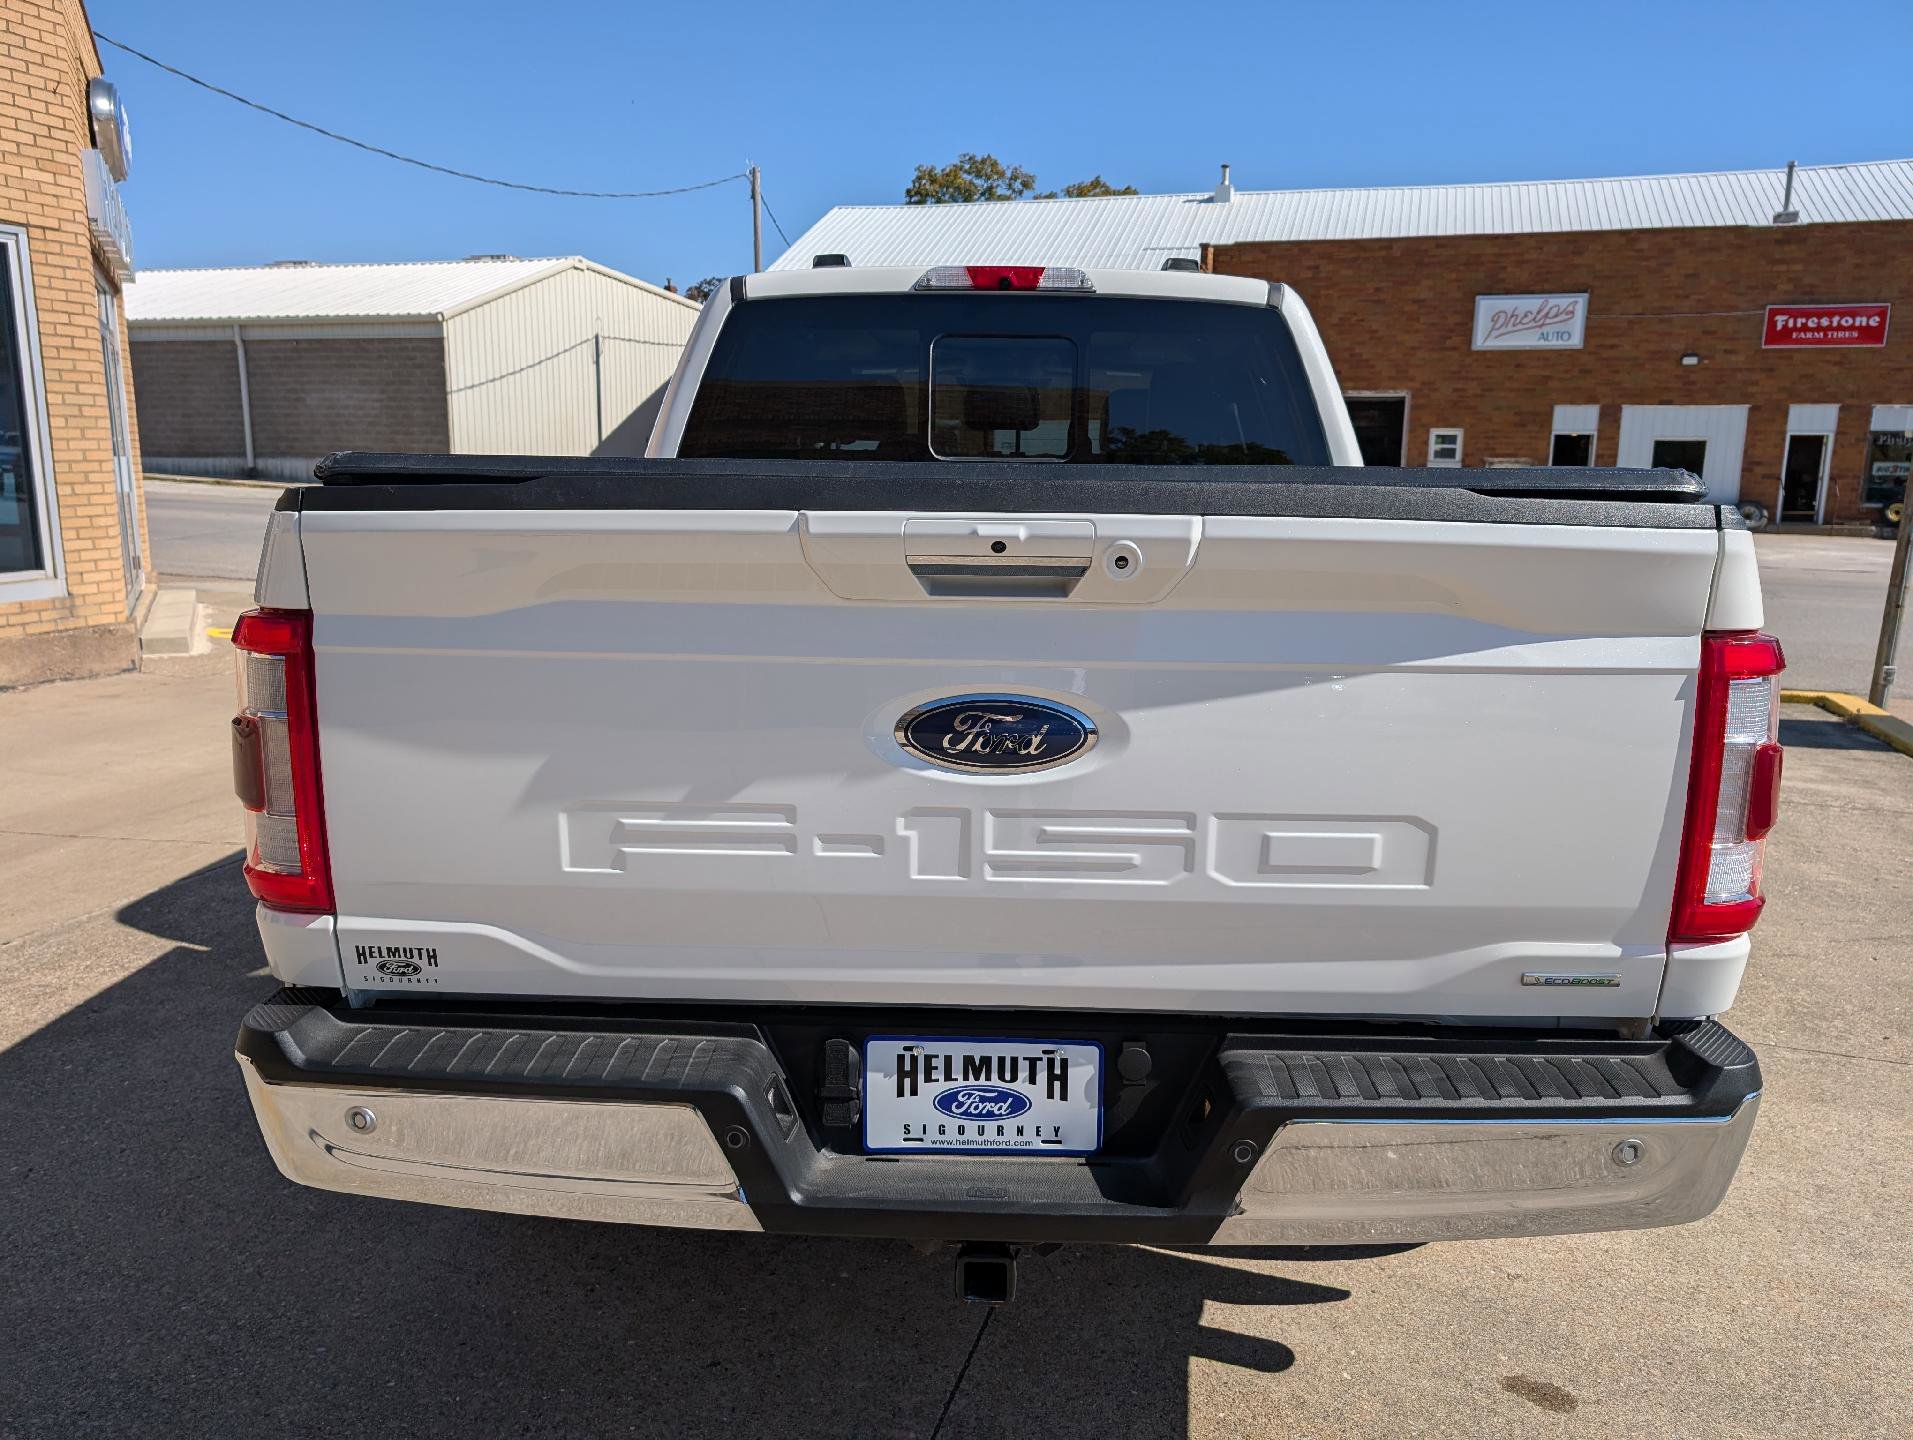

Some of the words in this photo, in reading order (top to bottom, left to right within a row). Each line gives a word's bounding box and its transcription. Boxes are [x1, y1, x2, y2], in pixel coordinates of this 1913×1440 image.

[1482, 299, 1578, 344] Phelps
[1774, 314, 1881, 331] Firestone
[1537, 331, 1572, 342] AUTO
[1792, 331, 1823, 339] FARM
[1827, 331, 1858, 339] TIRES
[942, 712, 1049, 755] Ford
[559, 803, 1438, 889] F-150
[355, 945, 439, 967] HELMUTH
[384, 961, 414, 974] Ford
[896, 1053, 1069, 1101] HELMUTH
[951, 1090, 1012, 1116] Ford
[903, 1123, 1061, 1138] SIGOURNEY
[930, 1138, 1034, 1148] www.helmuthford.com
